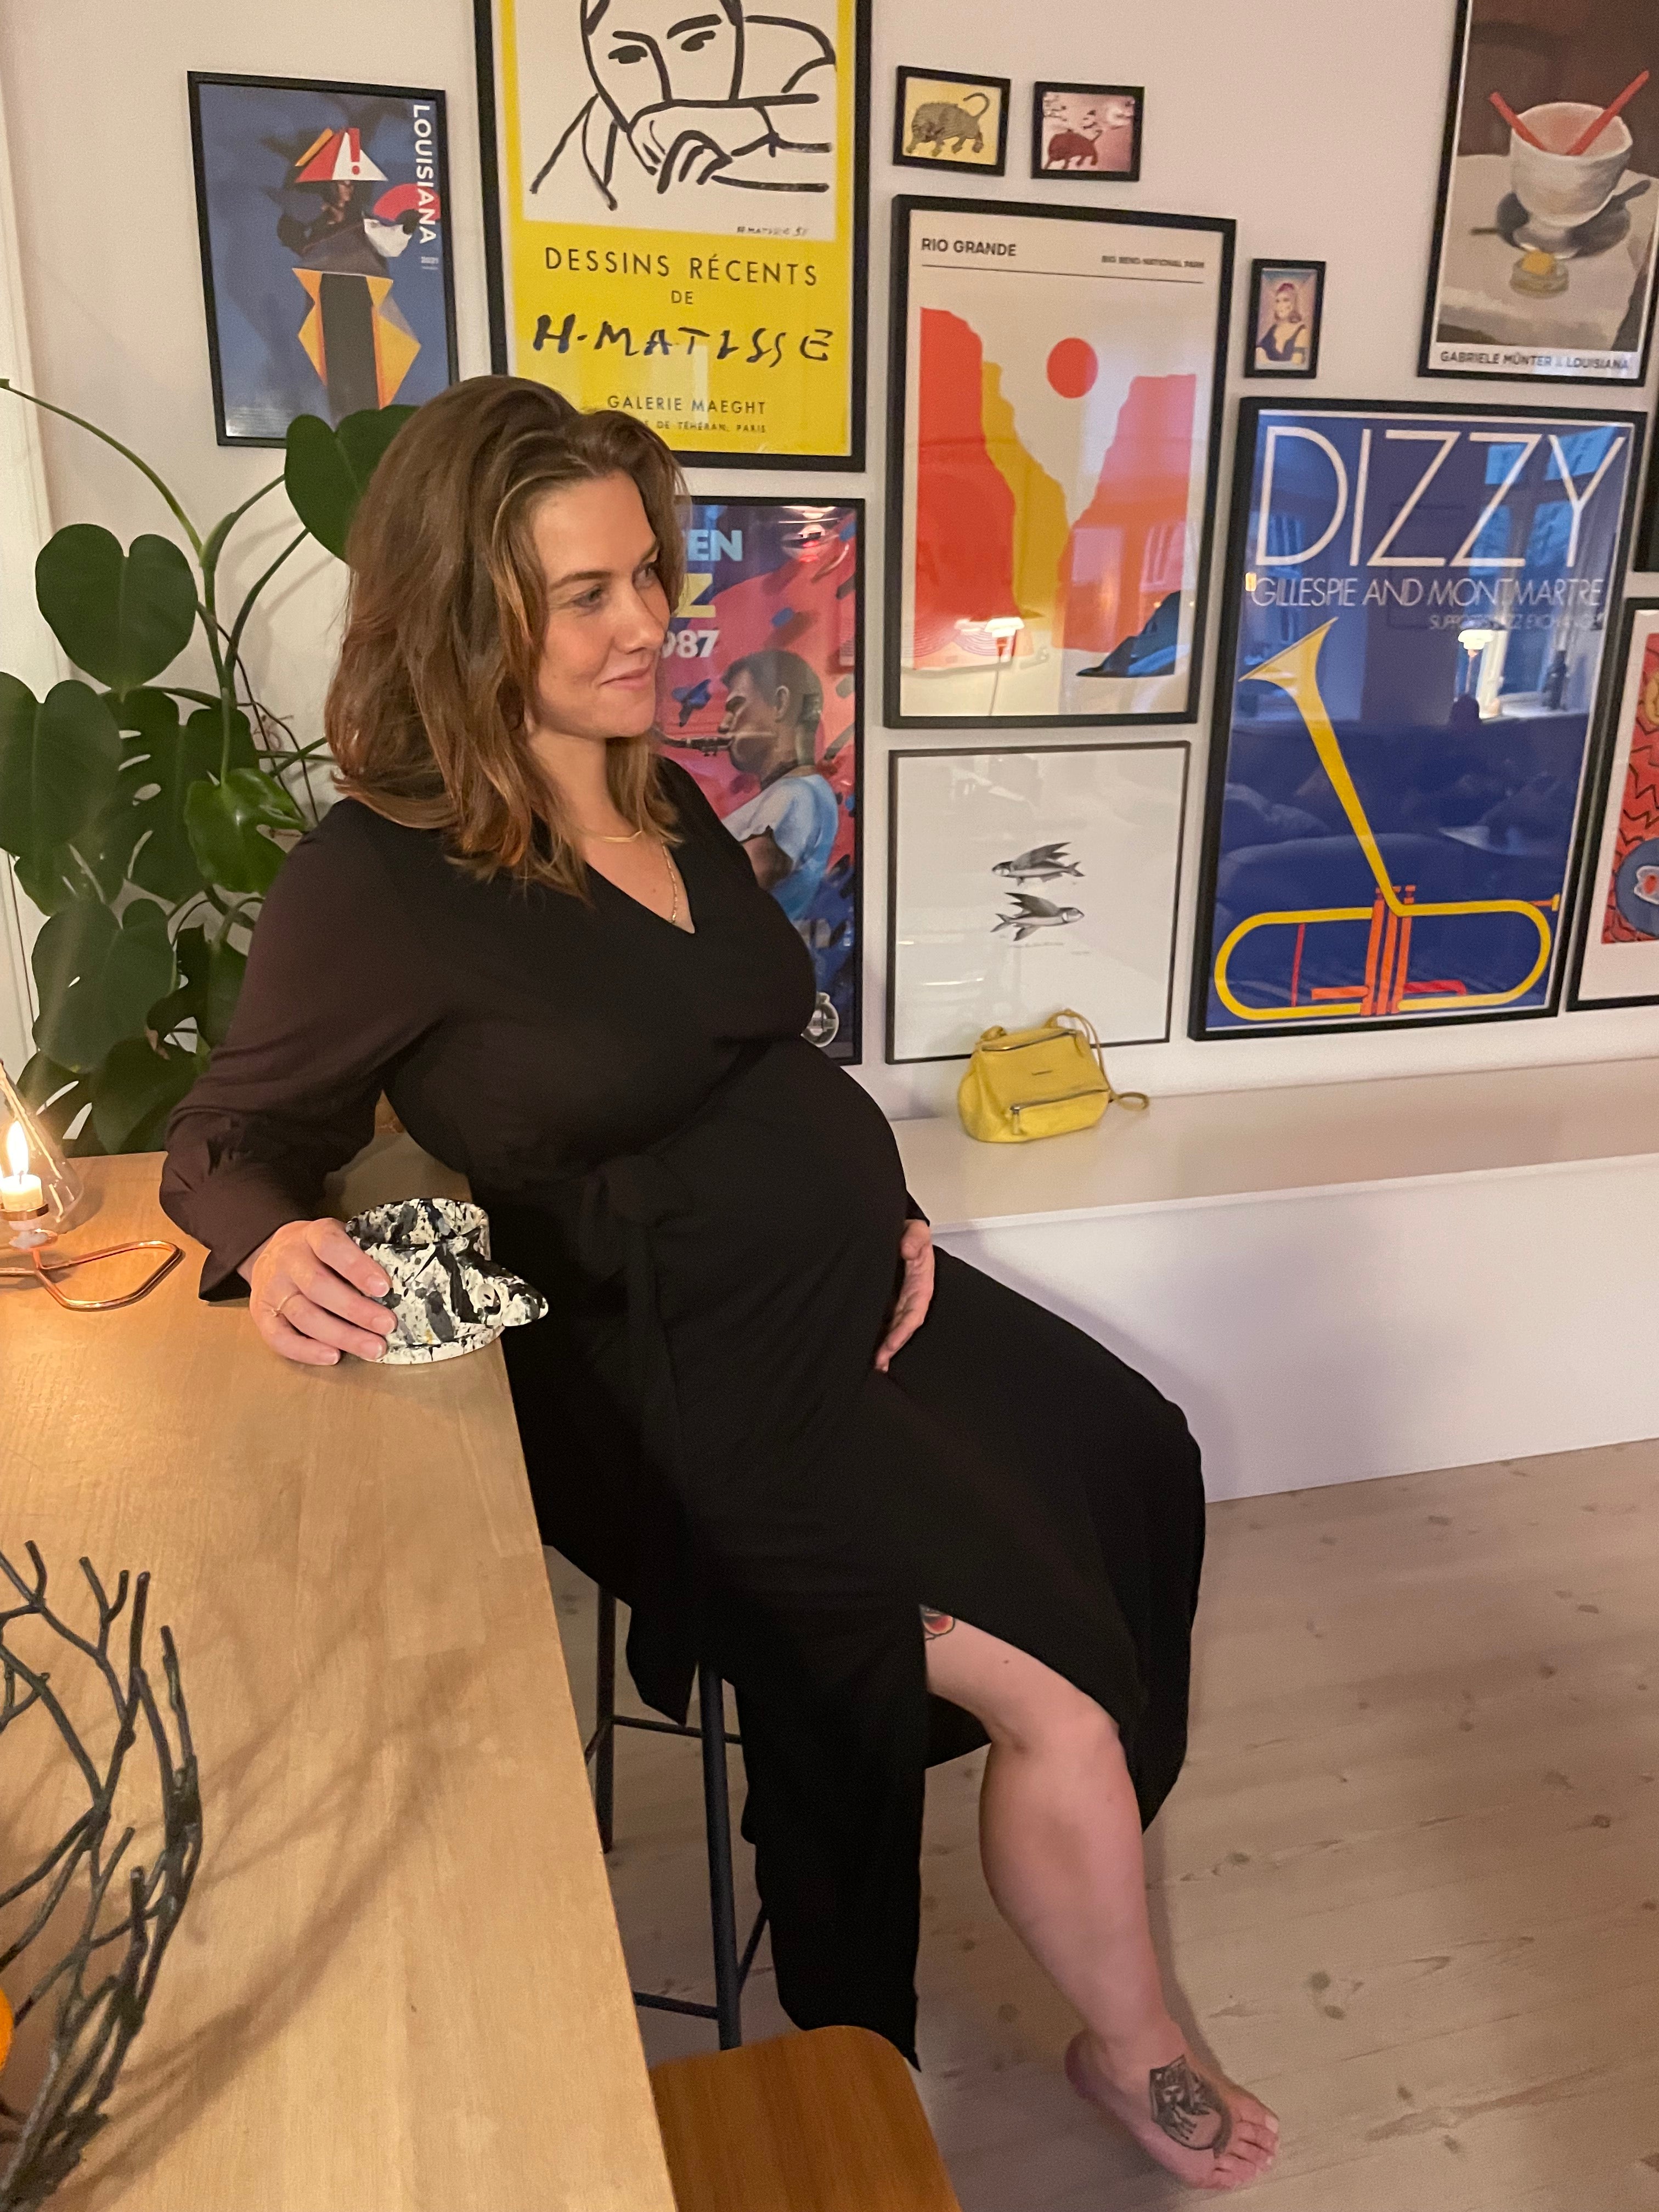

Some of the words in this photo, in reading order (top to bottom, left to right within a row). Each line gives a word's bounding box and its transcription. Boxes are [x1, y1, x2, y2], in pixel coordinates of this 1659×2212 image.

[413, 104, 436, 244] LOUISIANA
[922, 238, 948, 252] RIO
[953, 240, 1016, 256] GRANDE
[545, 246, 670, 277] DESSINS
[690, 253, 817, 286] RÉCENTS
[670, 290, 693, 305] DE
[1441, 350, 1500, 364] GABRIELE
[1503, 352, 1552, 366] MÜNTER
[1567, 356, 1628, 369] LOUISIANA
[607, 395, 682, 411] GALERIE
[691, 399, 766, 415] MAEGHT
[1255, 426, 1626, 568] DIZZY
[684, 529, 743, 562] EN
[1251, 577, 1358, 606] GILLESPIE
[1362, 578, 1424, 606] AND
[1427, 578, 1604, 607] MONTMARTRE
